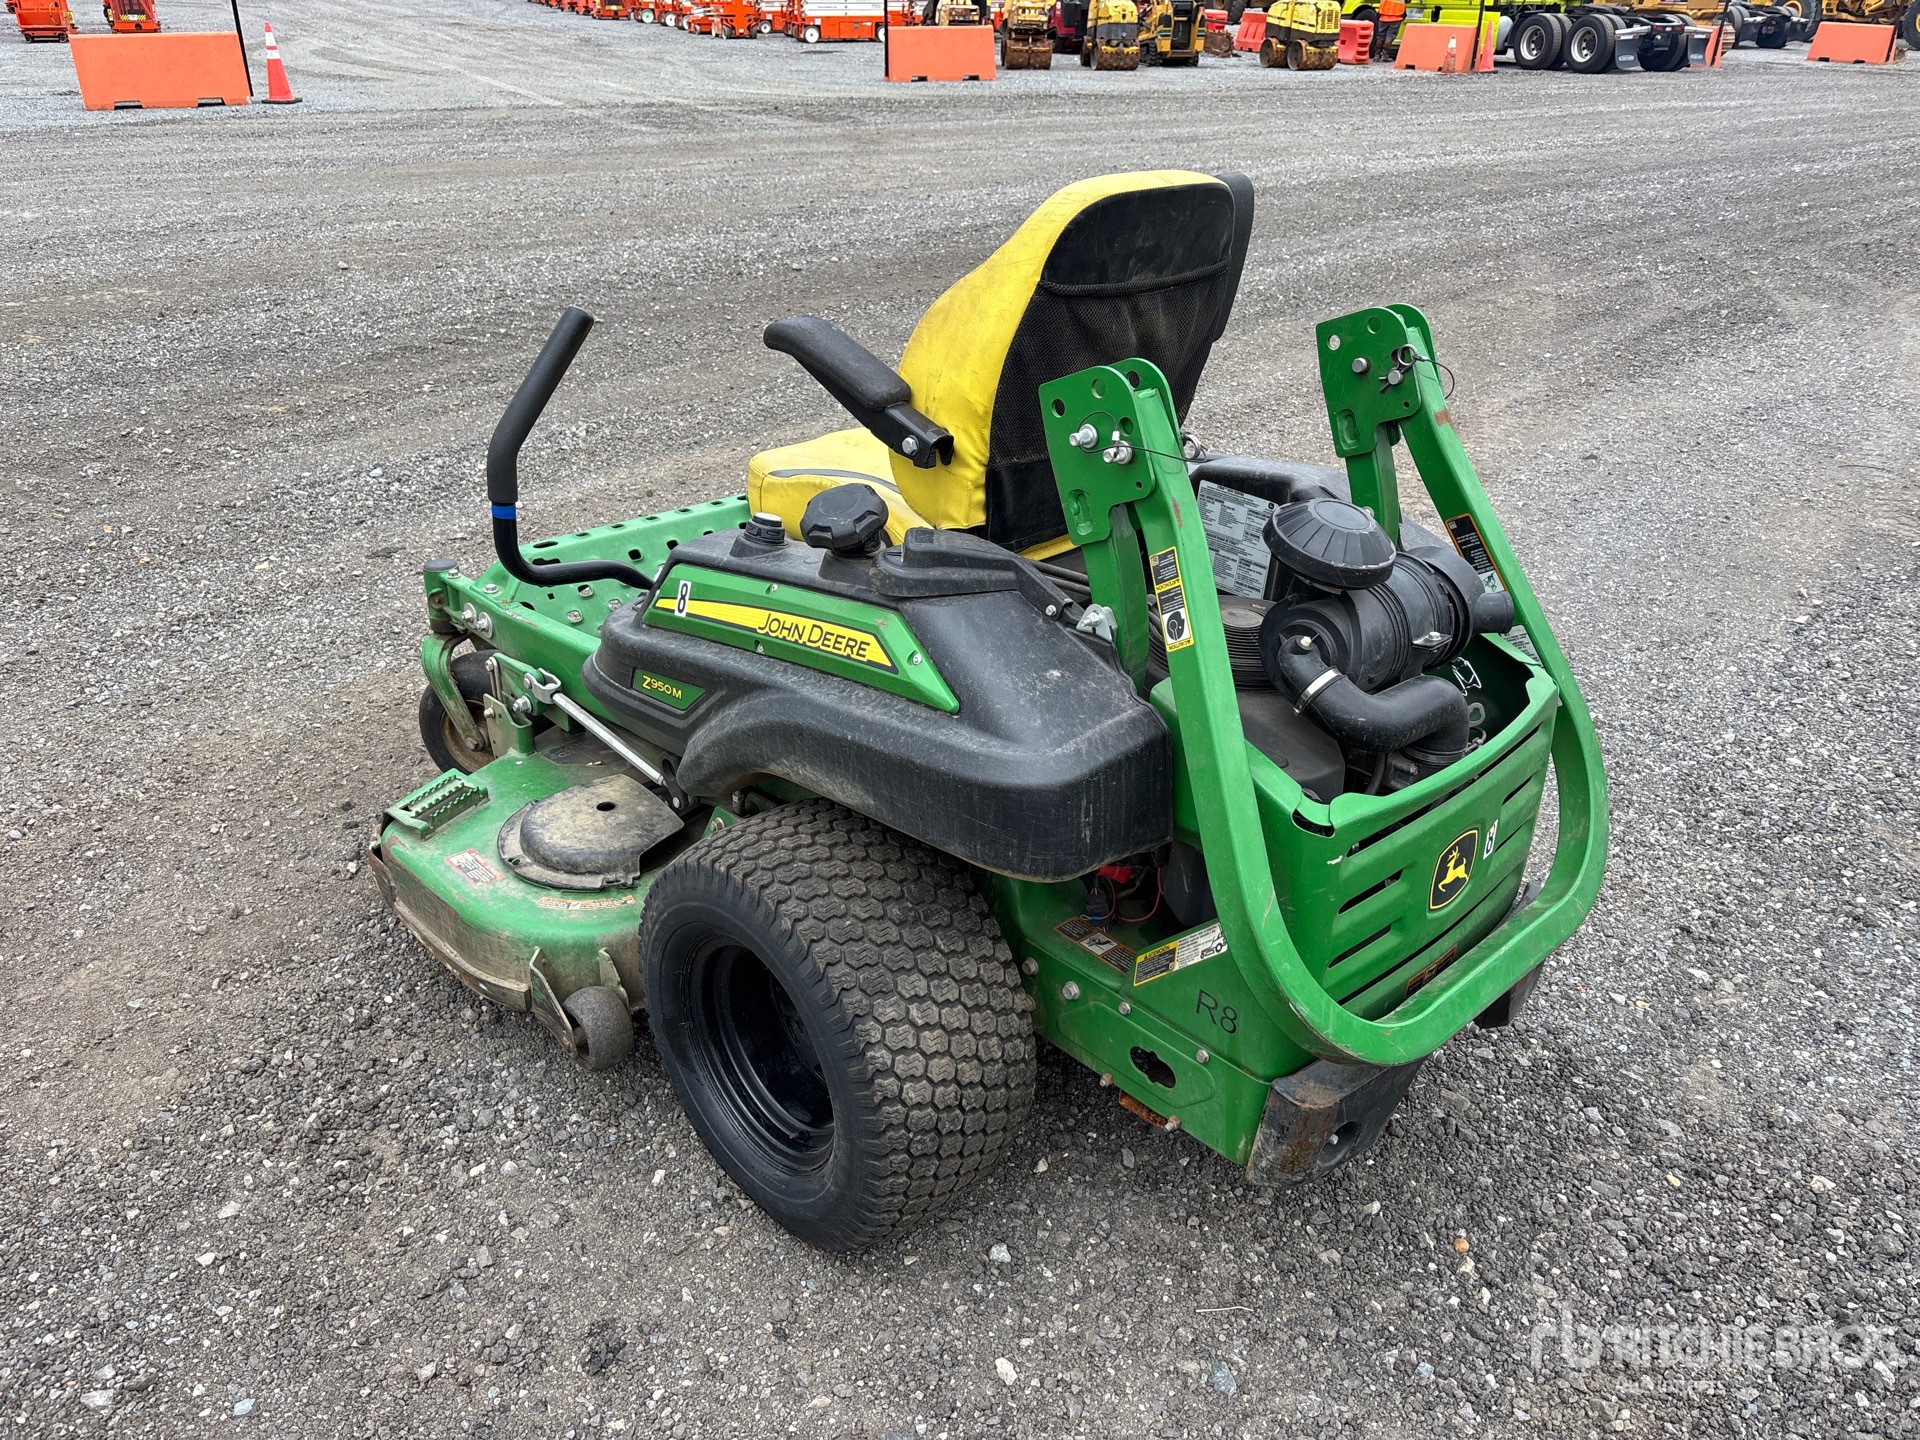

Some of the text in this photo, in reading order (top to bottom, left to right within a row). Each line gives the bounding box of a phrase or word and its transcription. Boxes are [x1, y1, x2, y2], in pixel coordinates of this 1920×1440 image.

[676, 583, 689, 613] 8
[757, 613, 871, 658] JOHN DEERE
[642, 675, 682, 700] Z950M
[1196, 989, 1238, 1034] R8
